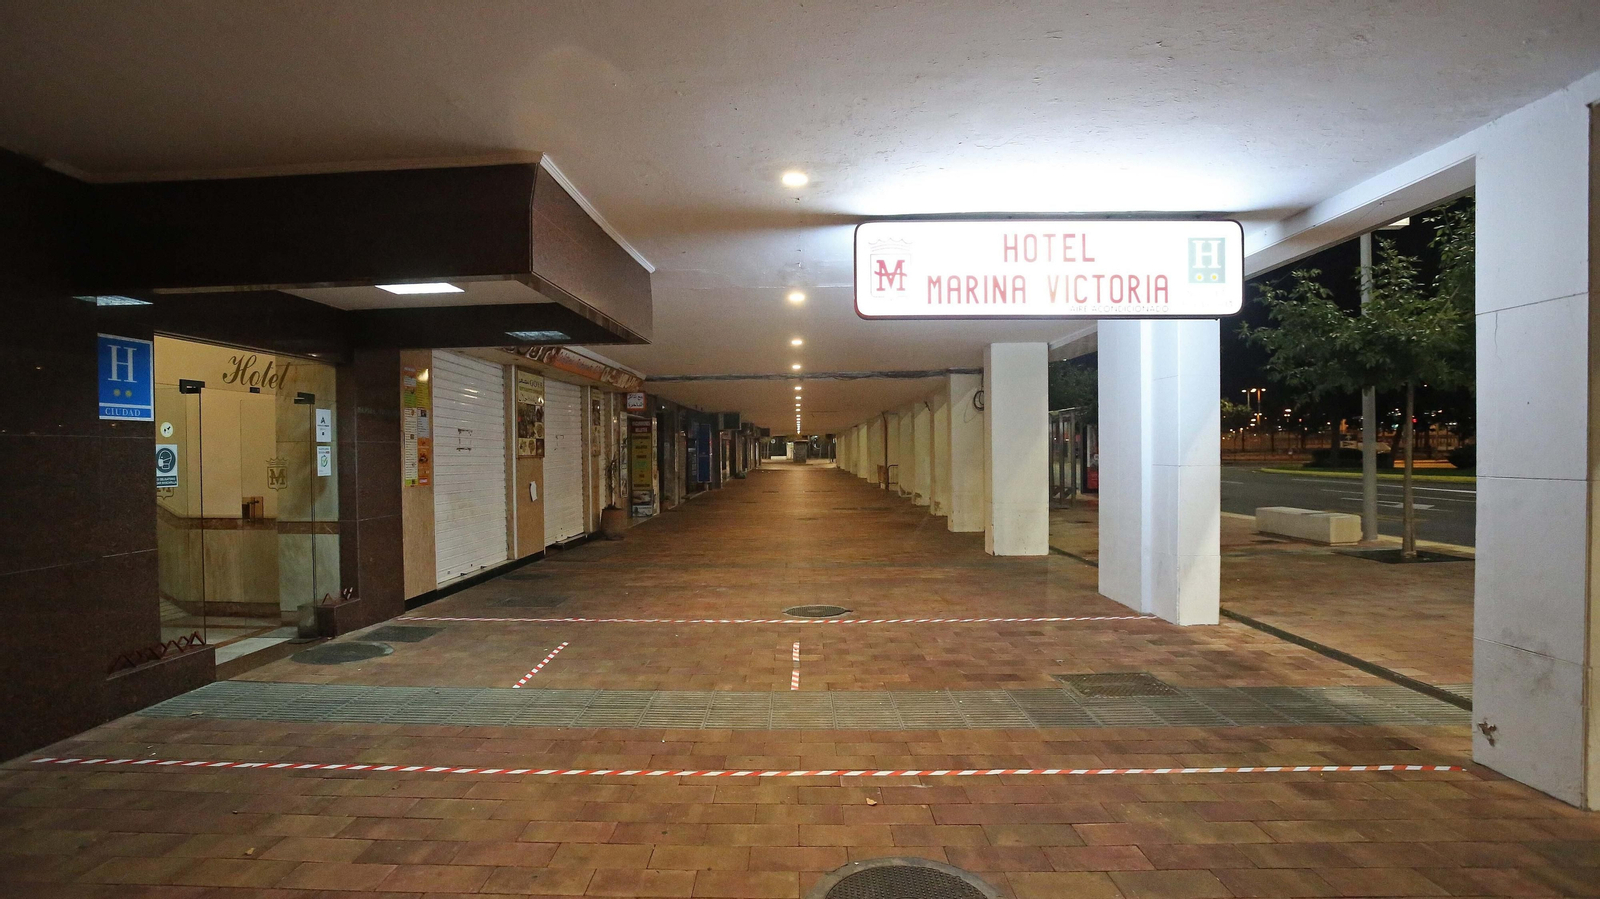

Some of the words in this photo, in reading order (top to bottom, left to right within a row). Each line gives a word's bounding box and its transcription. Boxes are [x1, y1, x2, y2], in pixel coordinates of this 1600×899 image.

[1003, 233, 1096, 263] HOTEL
[1192, 240, 1222, 269] H
[926, 274, 1027, 304] MARINA
[1048, 274, 1169, 304] VICTORIA
[1070, 305, 1088, 313] AIRE
[1091, 305, 1169, 313] ACONDICIONADO
[107, 344, 138, 383] H
[222, 354, 291, 391] Hotel
[104, 406, 141, 417] CIUDAD
